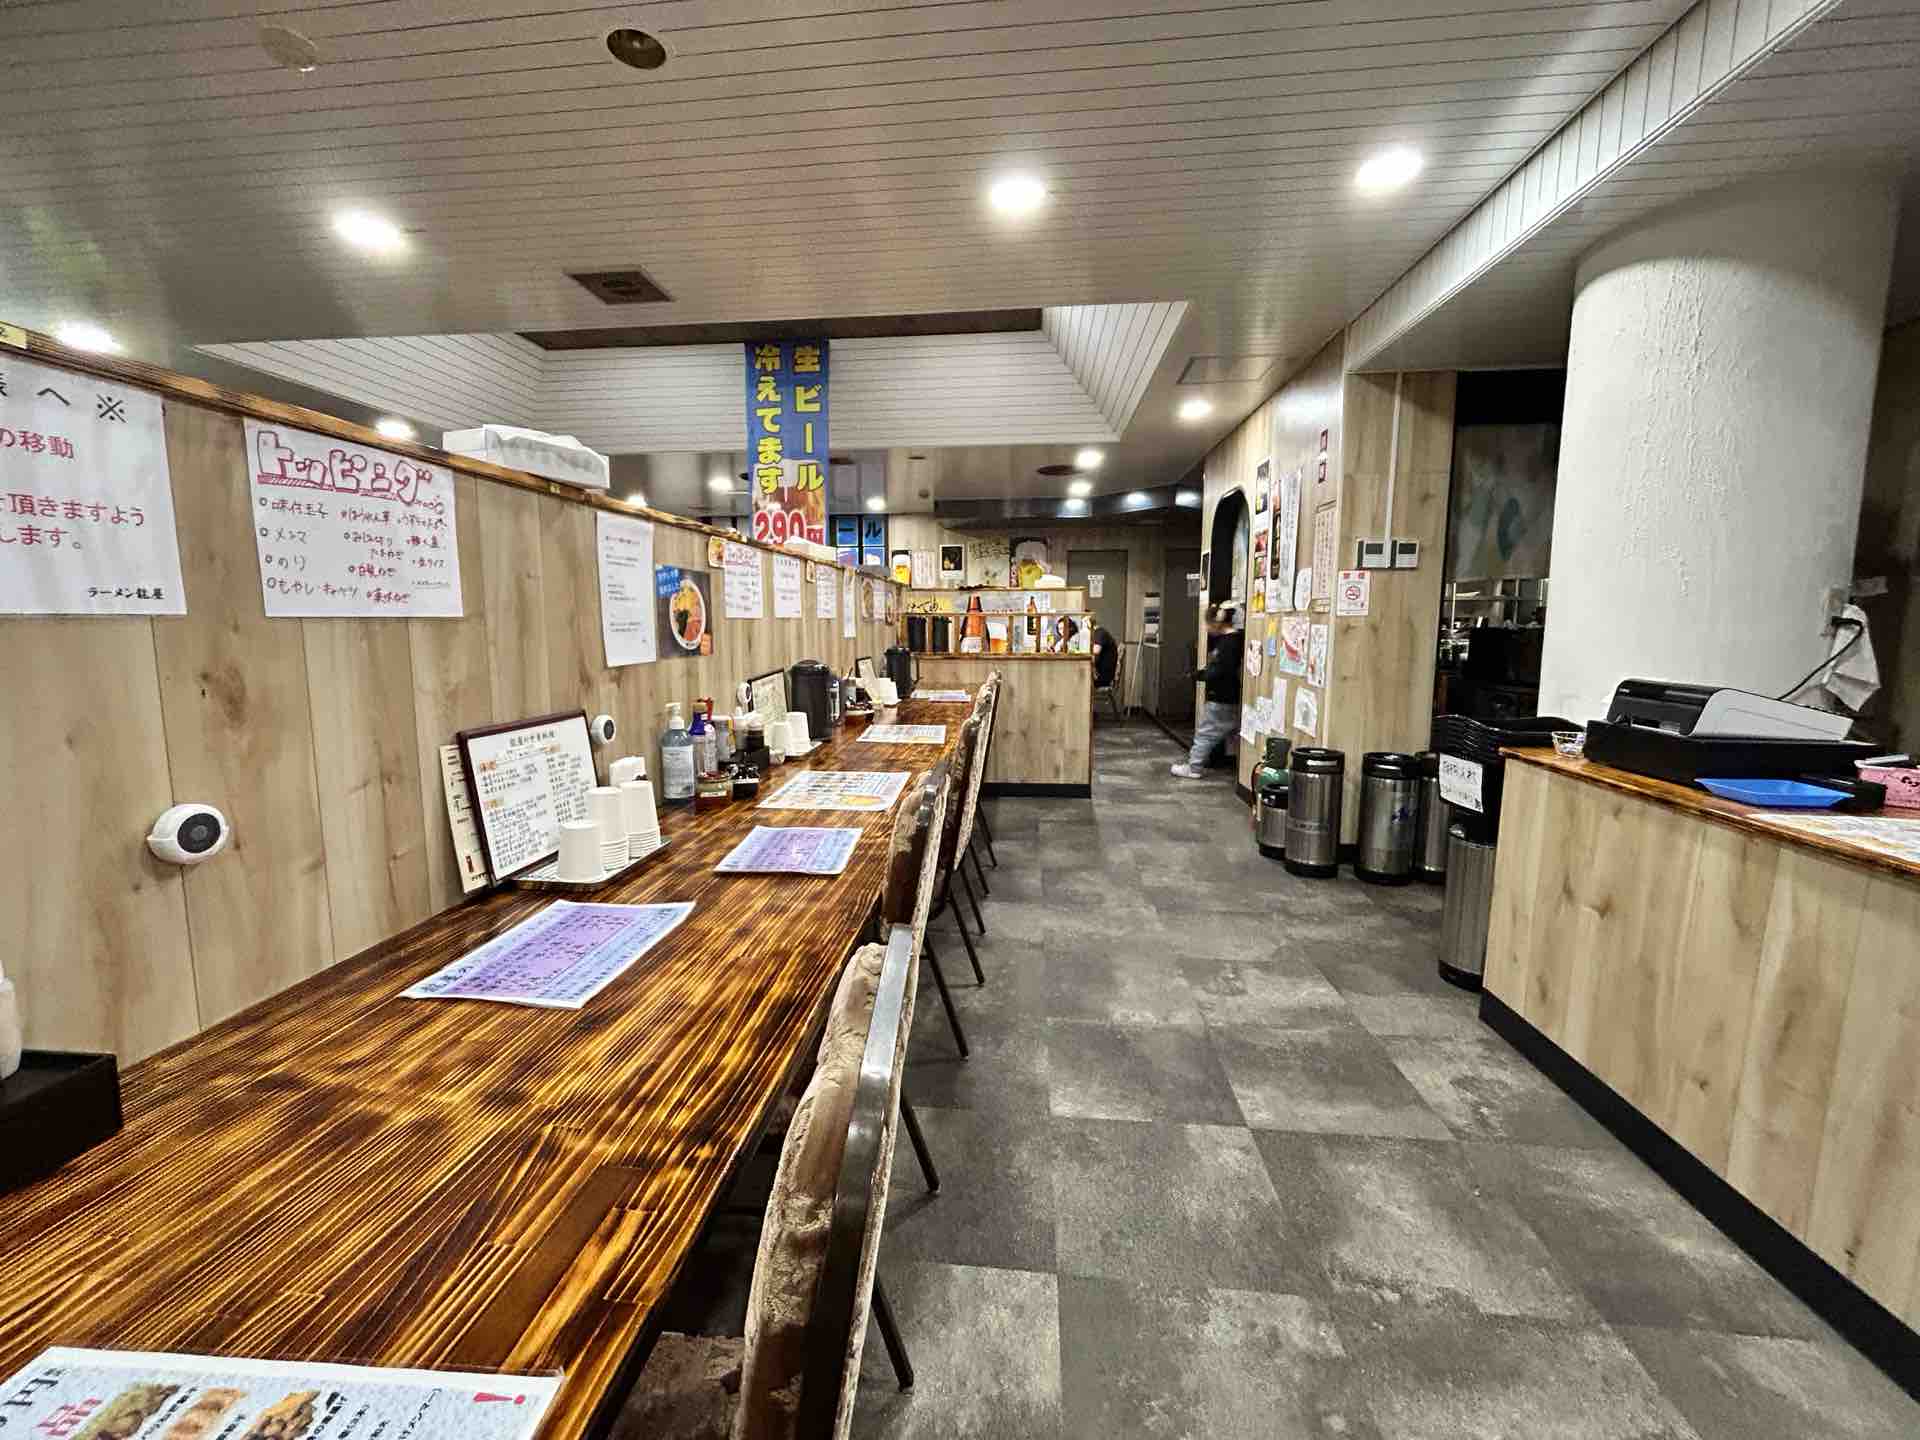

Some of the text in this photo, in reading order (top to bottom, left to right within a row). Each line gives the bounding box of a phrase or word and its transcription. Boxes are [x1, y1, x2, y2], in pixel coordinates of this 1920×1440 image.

[755, 344, 784, 494] 冷えてます
[275, 528, 307, 545] メンマ
[278, 555, 305, 571] のり
